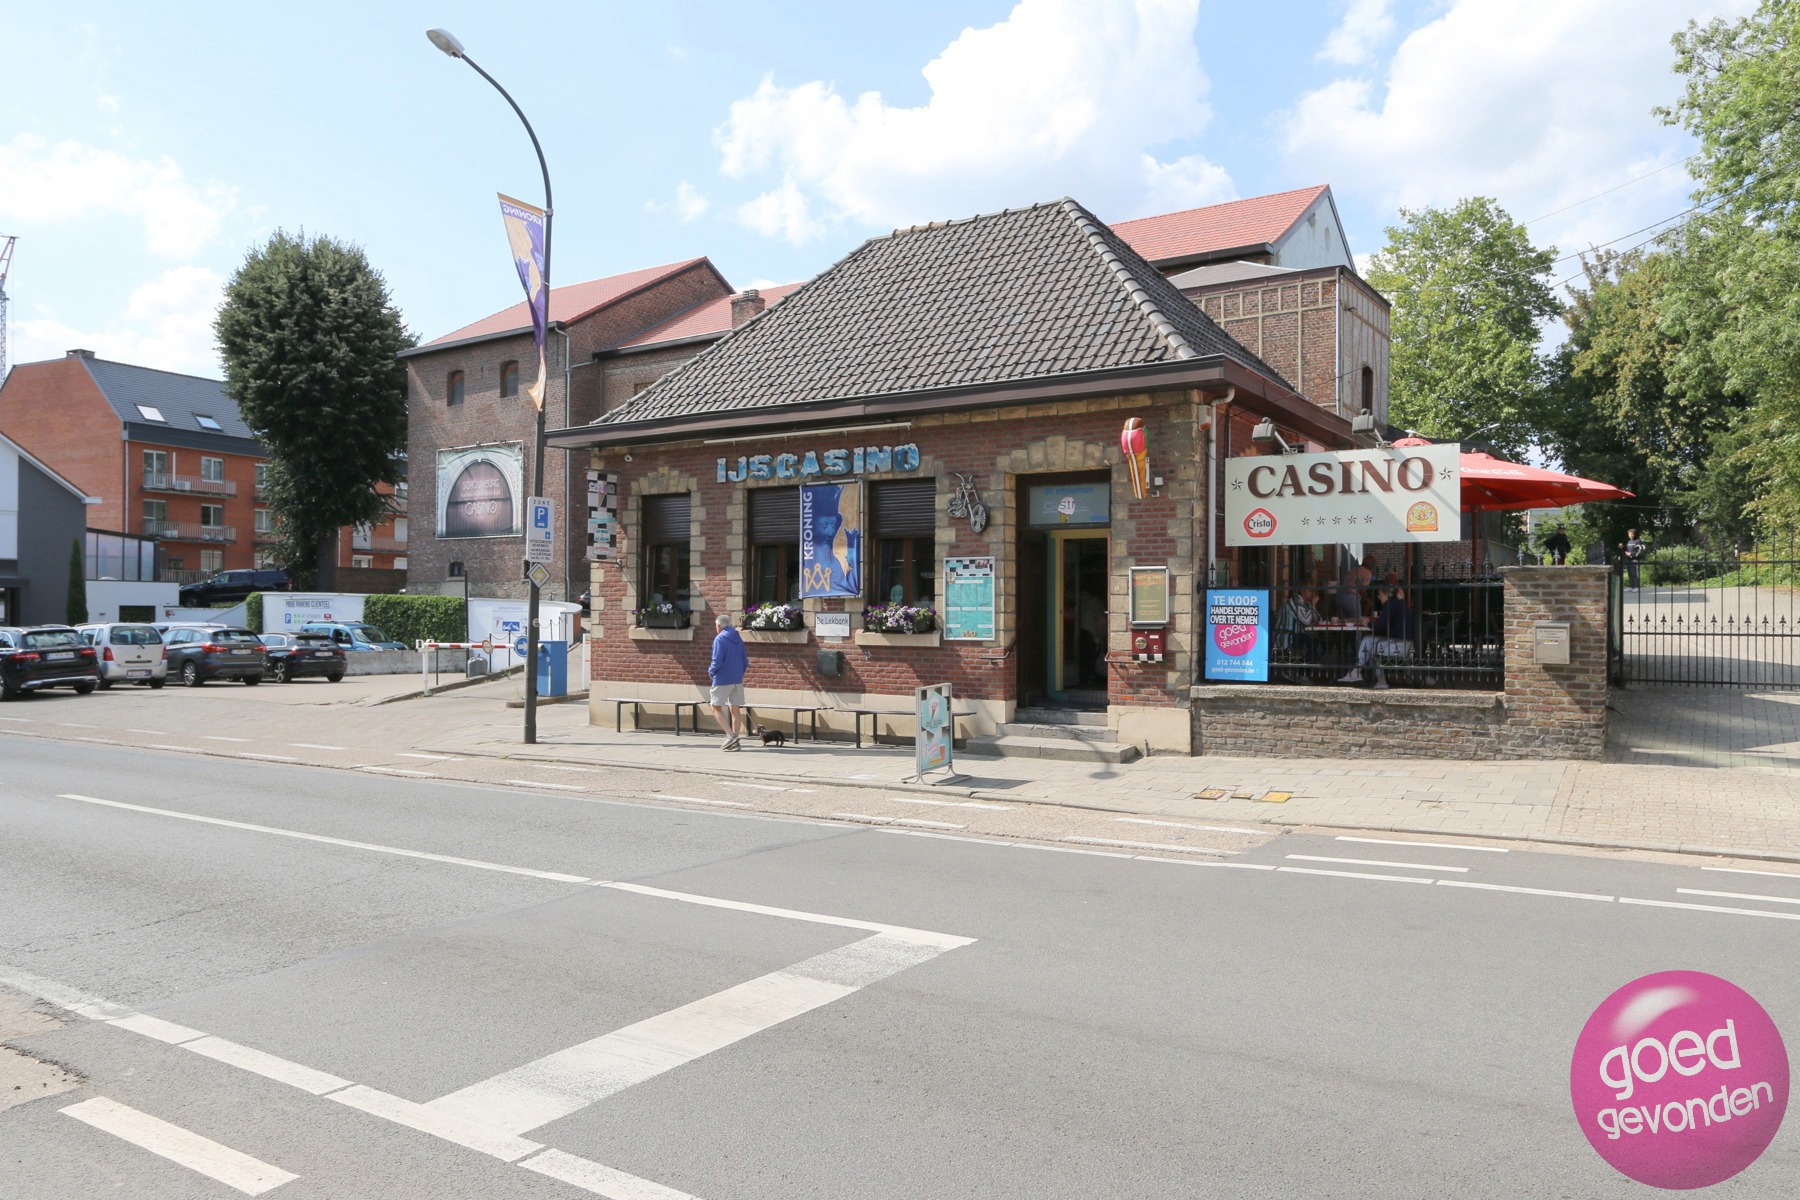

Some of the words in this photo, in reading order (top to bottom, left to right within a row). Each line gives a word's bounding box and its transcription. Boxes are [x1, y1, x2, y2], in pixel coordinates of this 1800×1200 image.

[716, 443, 920, 483] IJSCASINO
[1247, 456, 1434, 498] CASINO
[465, 500, 498, 515] CASINO
[803, 491, 814, 560] KRONING
[1247, 518, 1273, 530] Cristal
[1213, 595, 1225, 606] TE
[1228, 595, 1257, 606] KOOP
[1210, 606, 1258, 615] HANDELSFONDS
[817, 616, 824, 625] De
[1210, 615, 1226, 624] OVER
[1227, 615, 1234, 624] TE
[1235, 615, 1258, 625] NEMEN
[1221, 632, 1254, 648] gevonden
